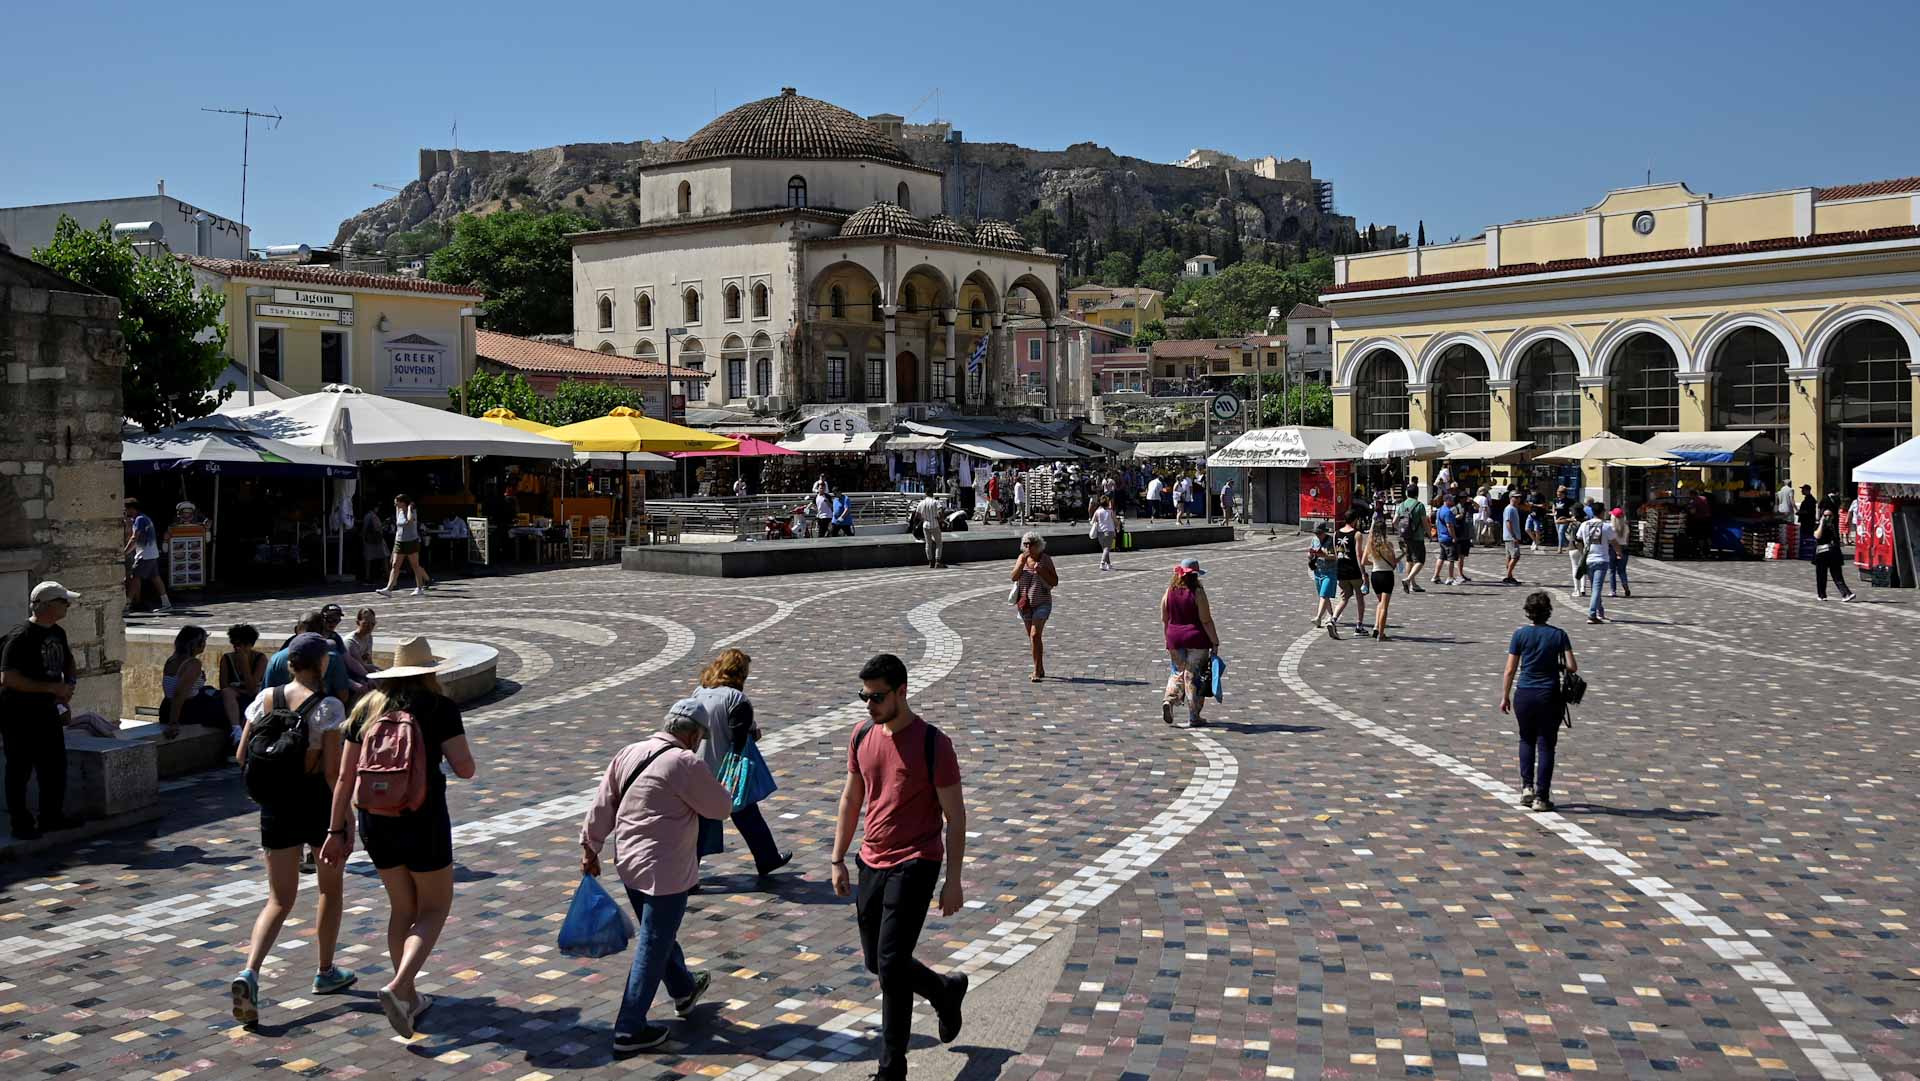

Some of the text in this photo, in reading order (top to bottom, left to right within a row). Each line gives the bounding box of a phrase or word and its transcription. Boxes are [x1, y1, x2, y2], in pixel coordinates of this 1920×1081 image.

[295, 291, 334, 304] Lagom
[395, 352, 434, 363] GREEK
[394, 364, 436, 376] SOUVENIRS
[819, 419, 854, 432] GES
